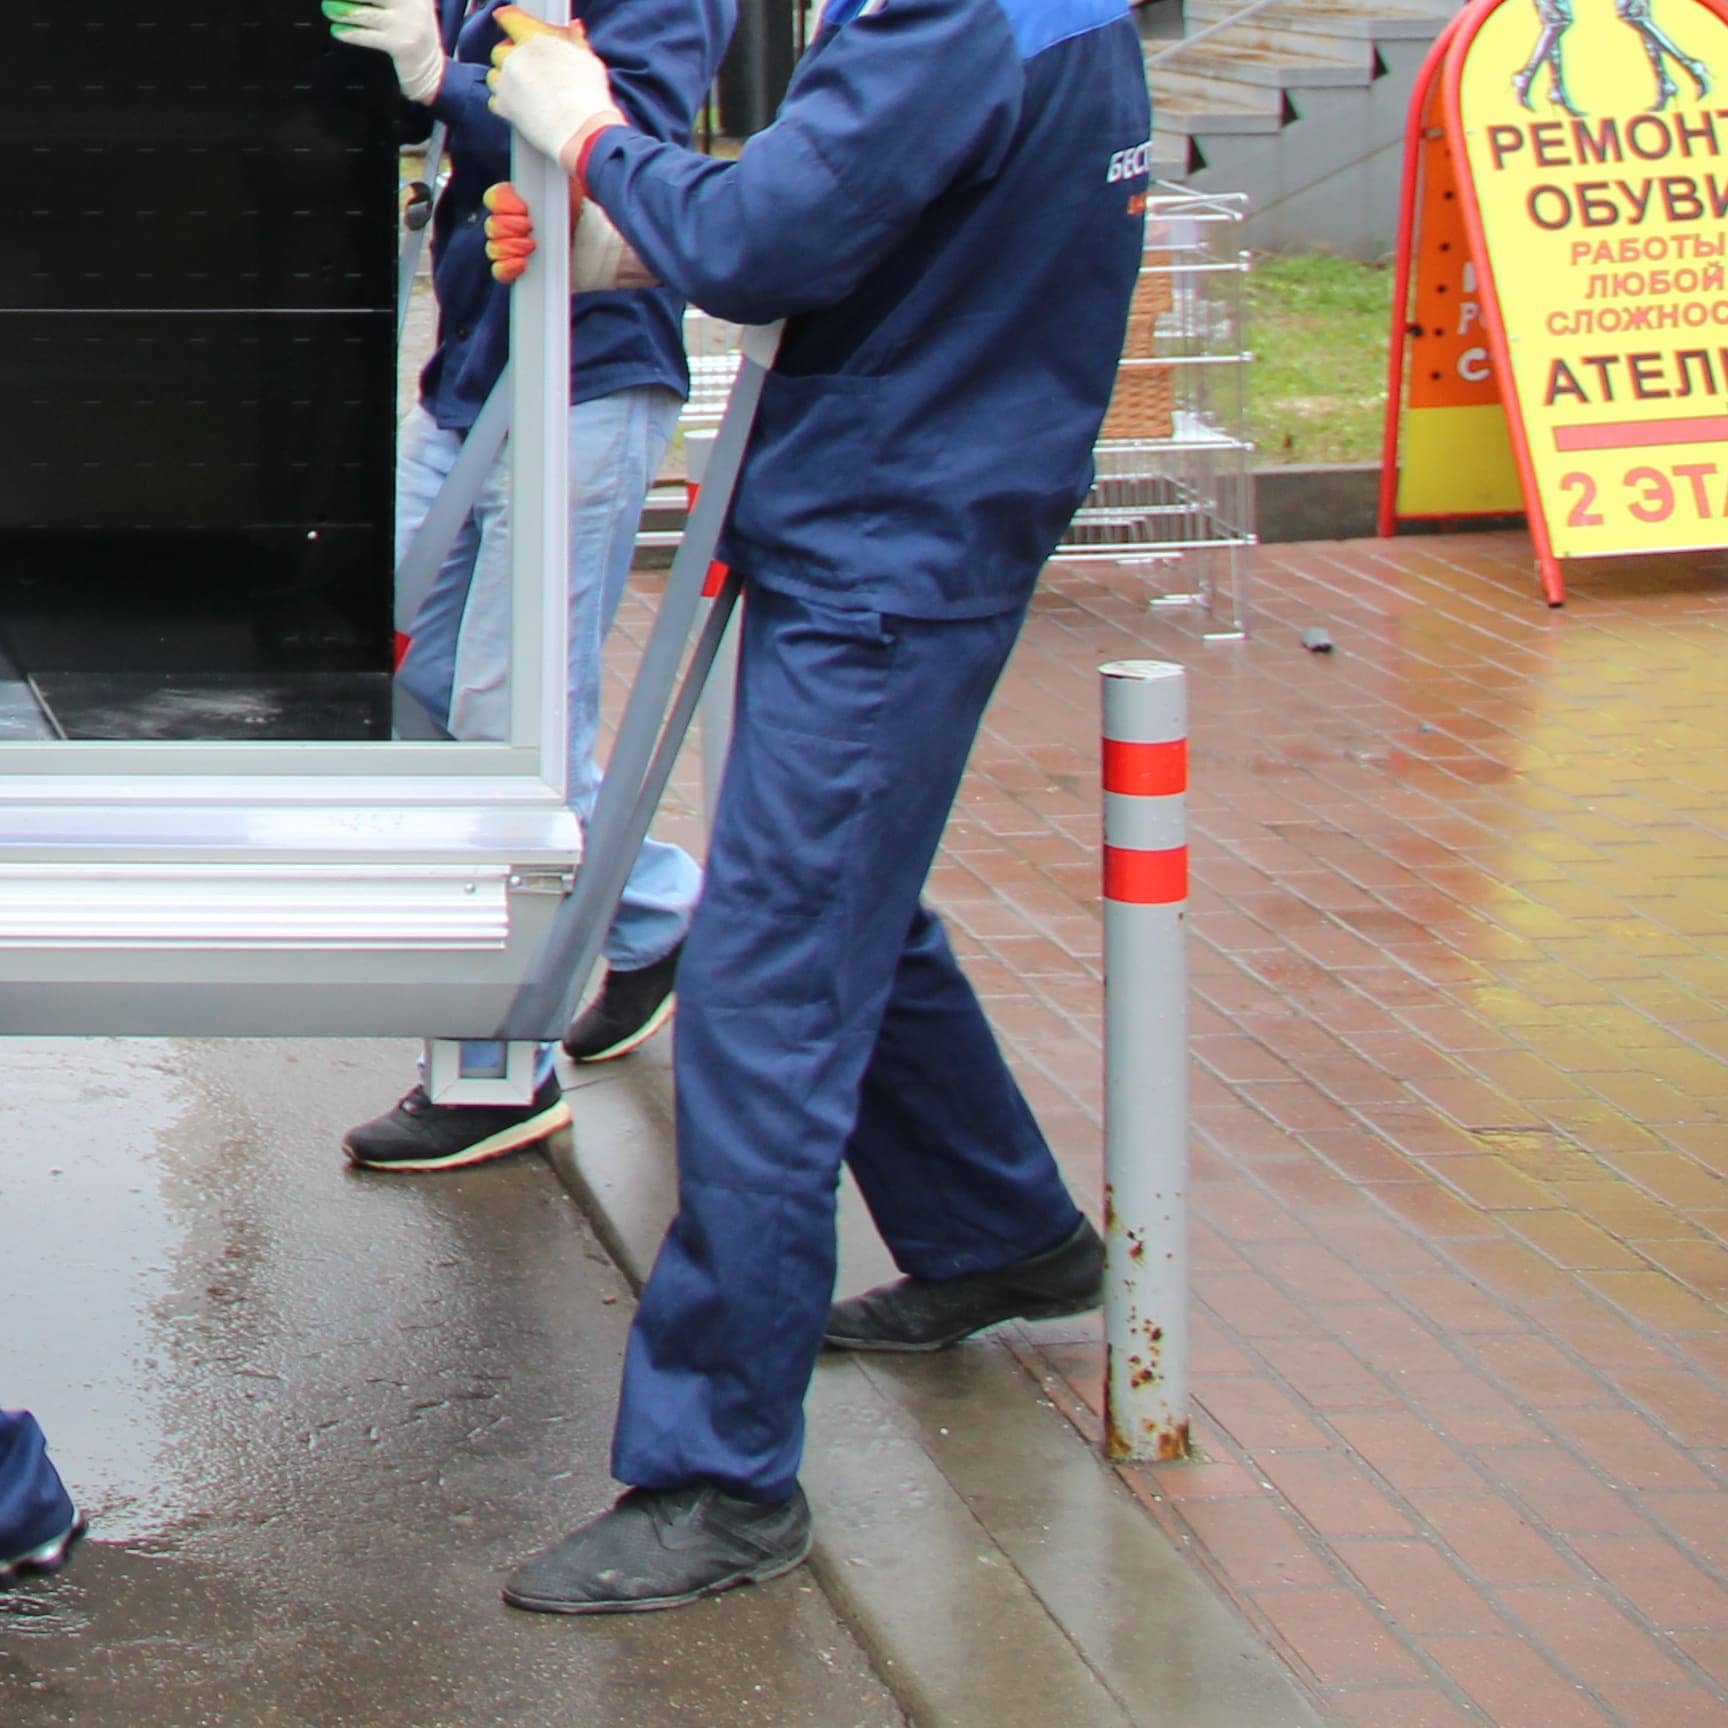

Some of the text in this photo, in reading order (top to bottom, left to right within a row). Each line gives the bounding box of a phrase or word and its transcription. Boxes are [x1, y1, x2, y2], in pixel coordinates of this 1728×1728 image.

[1570, 232, 1726, 266] РАБОТЫ
[1585, 261, 1725, 299] ЛЮБОЙ
[1559, 463, 1728, 527] 2 ЭТ
